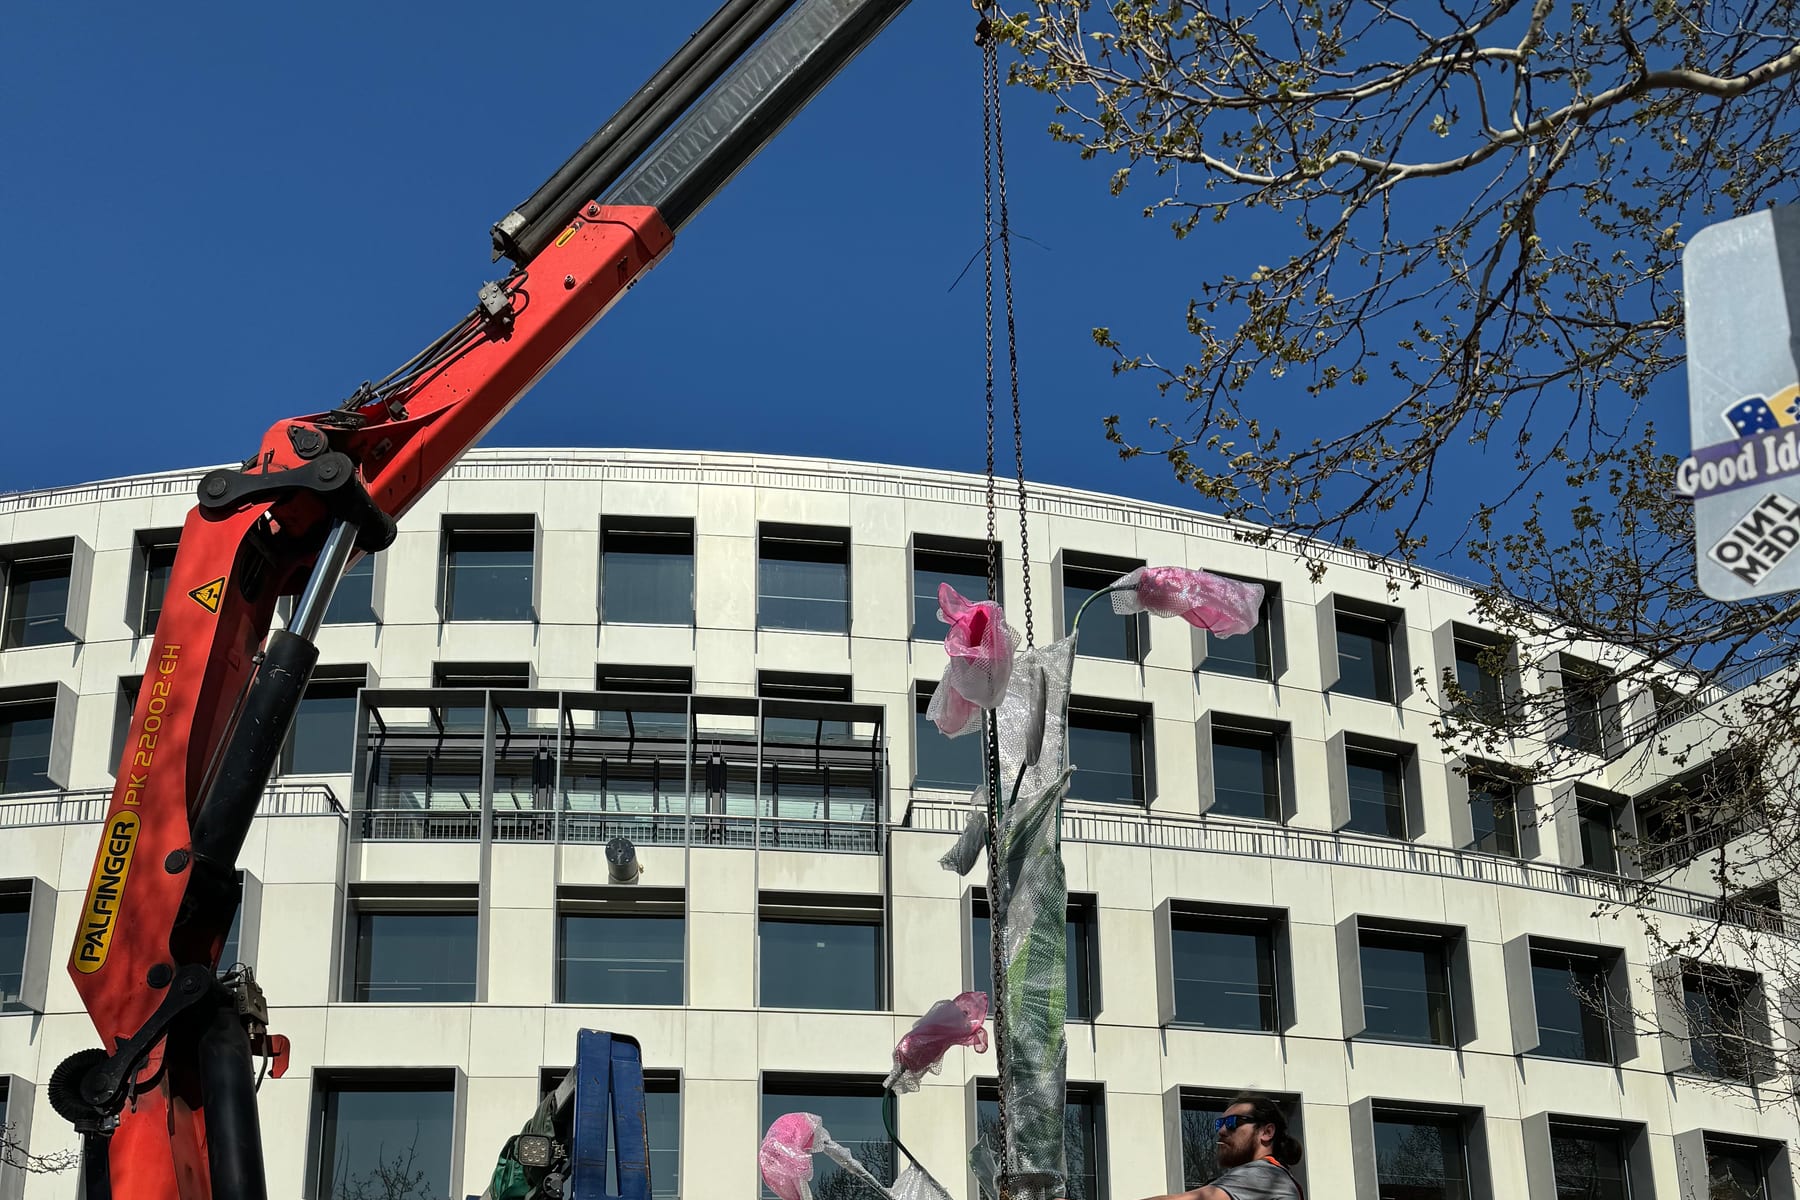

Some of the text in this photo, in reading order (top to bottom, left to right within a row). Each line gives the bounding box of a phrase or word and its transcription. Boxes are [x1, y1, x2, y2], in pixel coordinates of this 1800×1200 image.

[1676, 430, 1800, 495] Good Id
[124, 773, 147, 806] PK
[80, 820, 135, 963] PALFINGER
